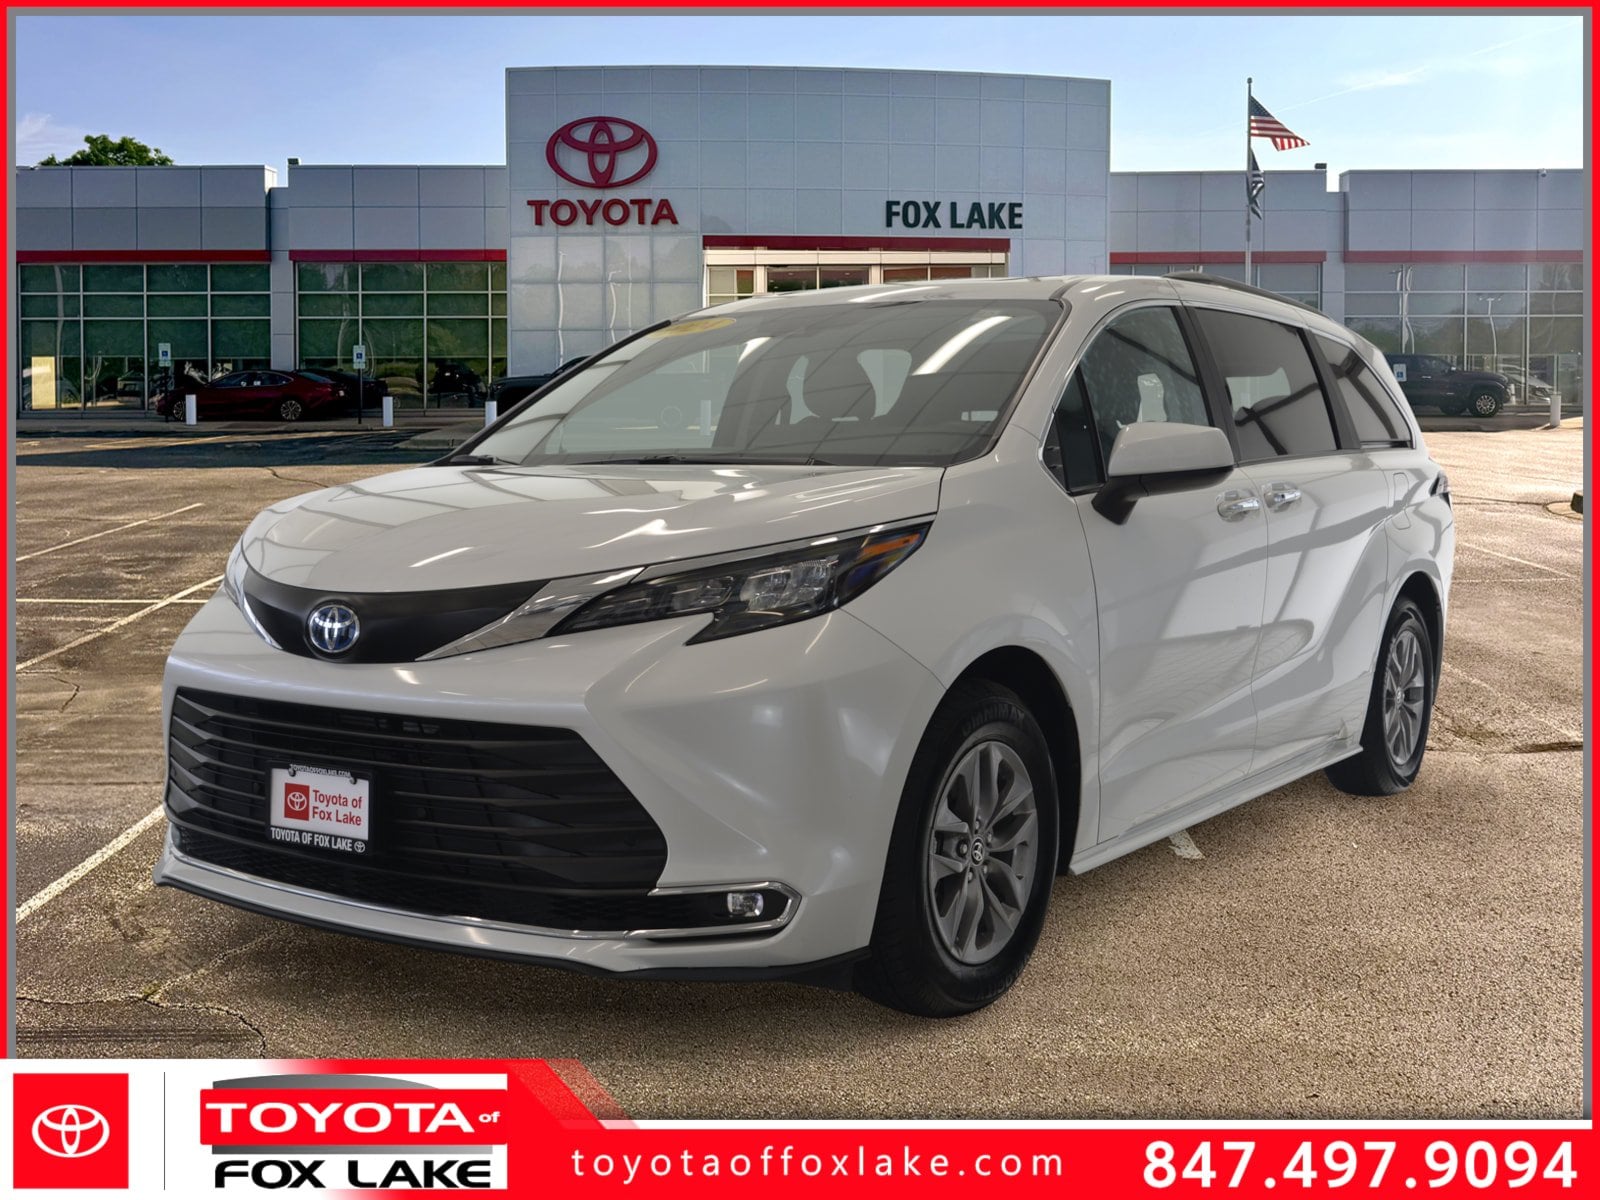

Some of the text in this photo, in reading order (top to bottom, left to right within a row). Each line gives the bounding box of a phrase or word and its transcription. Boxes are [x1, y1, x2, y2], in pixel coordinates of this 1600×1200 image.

[527, 199, 679, 226] TOYOTA
[886, 200, 1023, 229] FOX LAKE
[313, 789, 362, 809] Toyota of
[312, 806, 362, 826] Fox Lake
[270, 827, 353, 851] TOYOTA OF FOX LAKE
